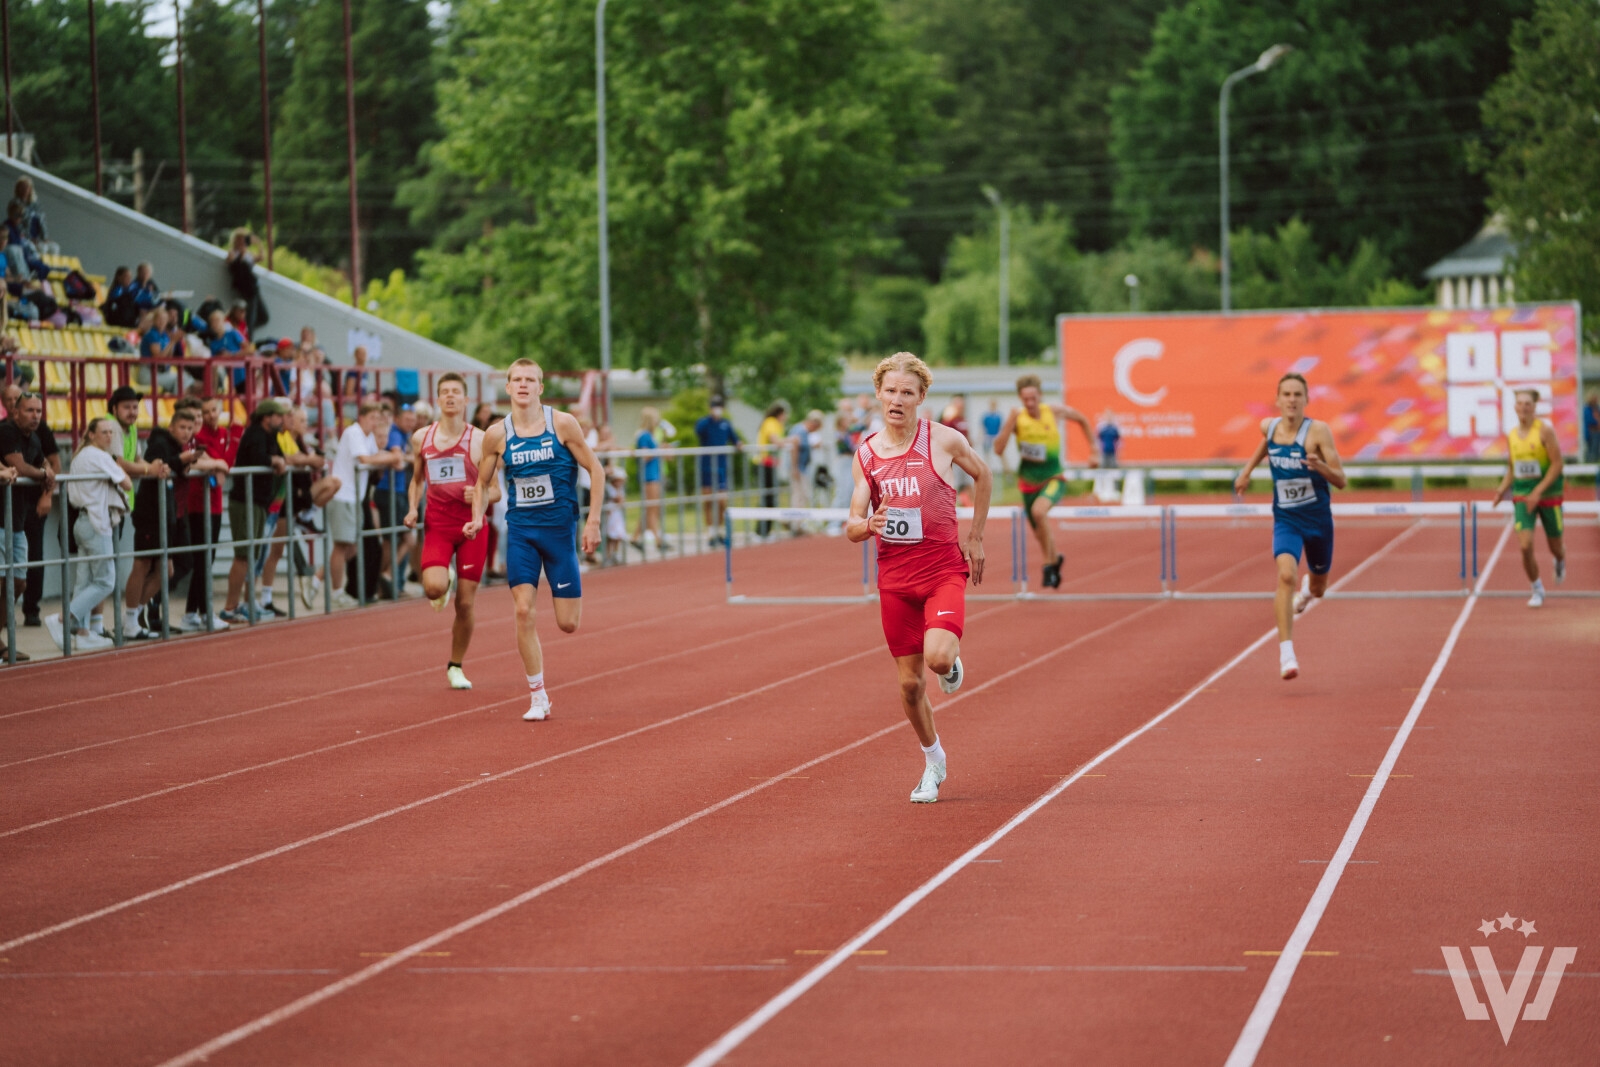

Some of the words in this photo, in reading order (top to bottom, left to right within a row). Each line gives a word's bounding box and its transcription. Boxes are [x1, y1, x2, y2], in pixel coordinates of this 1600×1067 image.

[511, 447, 555, 466] ESTONIA
[440, 465, 454, 478] 51
[521, 484, 546, 499] 189
[1284, 486, 1307, 500] 197
[885, 519, 909, 536] 50
